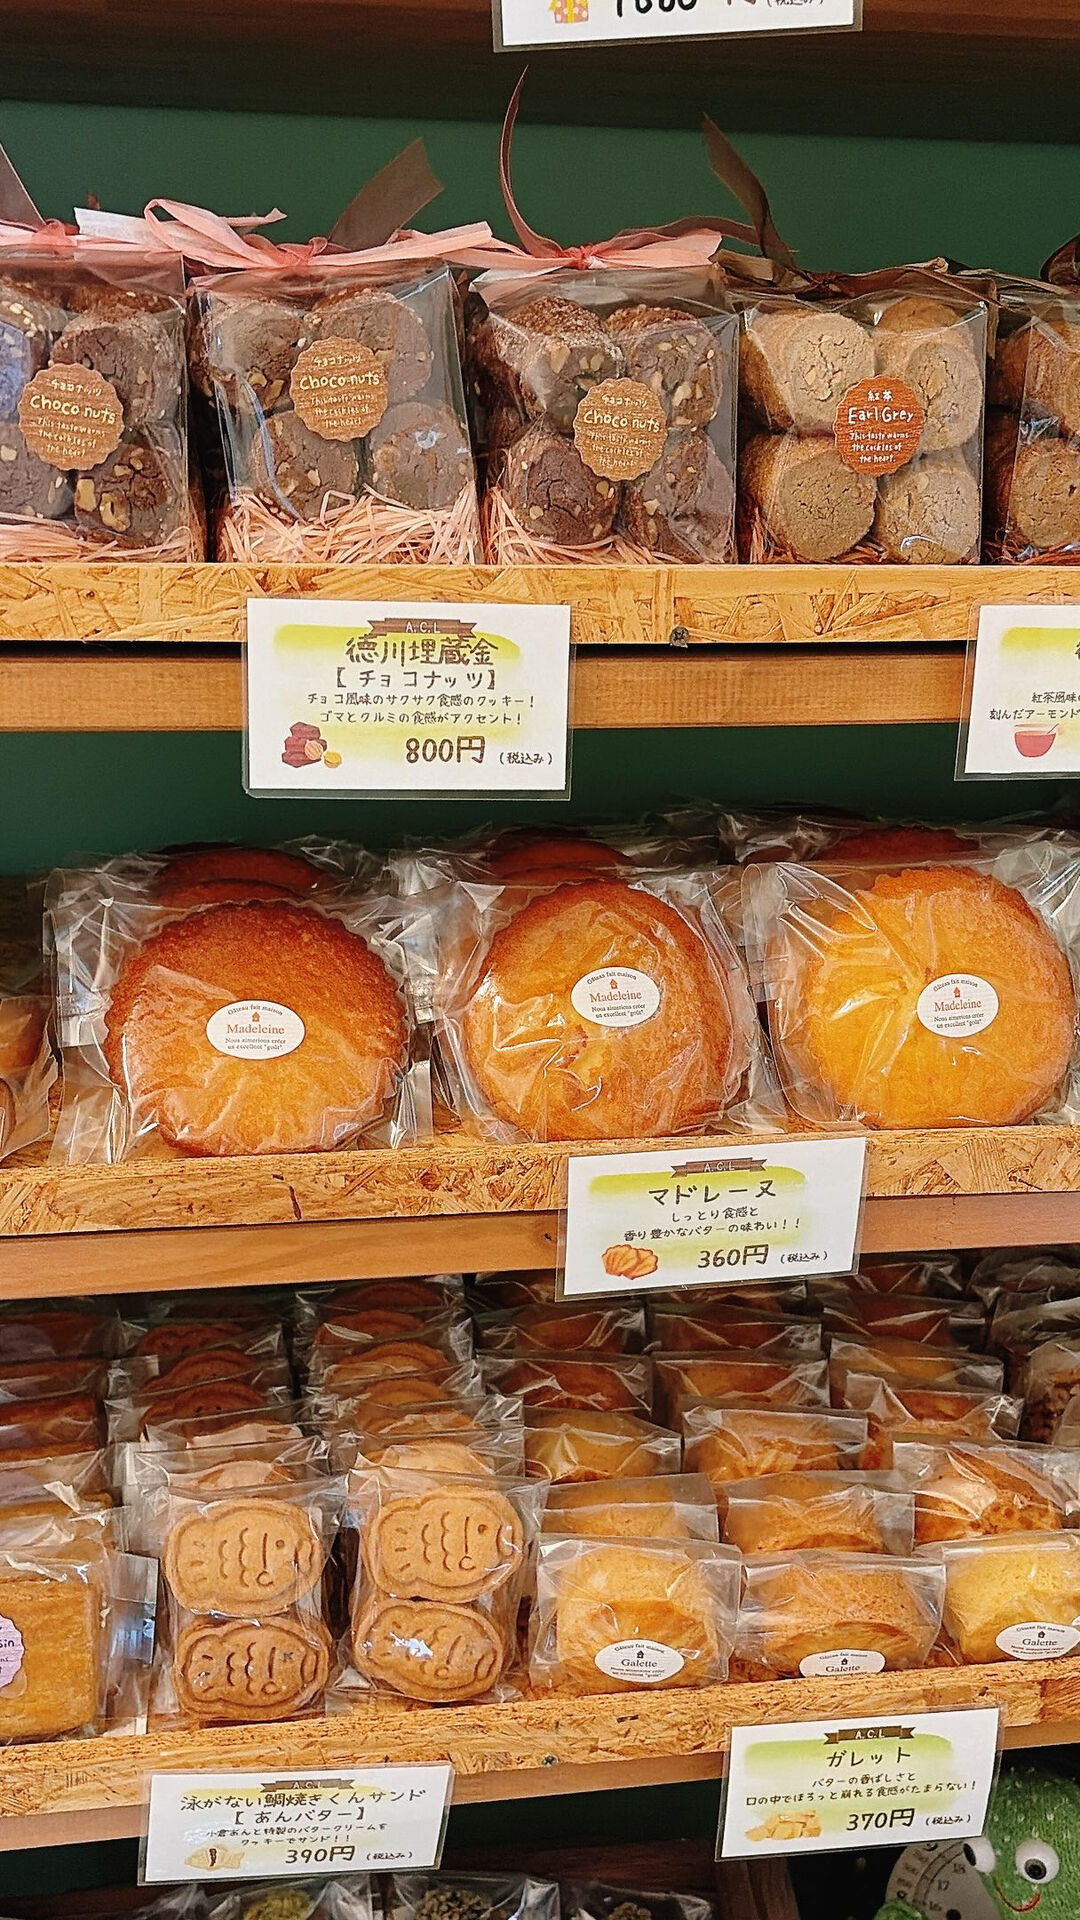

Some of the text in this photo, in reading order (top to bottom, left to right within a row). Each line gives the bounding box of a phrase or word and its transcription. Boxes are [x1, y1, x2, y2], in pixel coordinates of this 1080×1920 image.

[350, 371, 380, 386] nuts
[867, 390, 894, 401] 紅茶
[84, 406, 116, 425] nuts
[314, 408, 327, 416] the
[362, 404, 369, 414] of
[848, 406, 914, 424] Earl Grey
[325, 419, 338, 428] the
[632, 418, 660, 433] nuts
[39, 430, 52, 438] the
[87, 439, 97, 449] of
[849, 432, 865, 440] This
[867, 431, 886, 440] taste
[47, 444, 60, 453] the
[592, 444, 604, 452] the
[635, 449, 644, 458] of
[852, 444, 864, 452] the
[894, 443, 902, 452] of
[860, 454, 872, 464] the
[345, 636, 499, 668] 徳川埋蔵金
[336, 667, 496, 690] 【チョコナッツ】
[307, 692, 535, 708] チョコ風味のサクサク食感のクッキー！
[1031, 691, 1080, 704] 紅茶風味
[320, 711, 522, 726] ゴマとクルミの食感がアクセント！
[405, 735, 485, 765] 800円
[617, 972, 637, 980] maison
[589, 990, 642, 1003] Madeleine
[262, 1005, 283, 1016] maison
[934, 999, 982, 1012] Madeleine
[226, 1024, 285, 1034] Madeleine
[648, 1179, 777, 1206] マドレーヌ
[671, 1206, 759, 1223] しっとり食感と
[697, 1243, 769, 1269] 360円
[1022, 1638, 1058, 1646] Galette
[621, 1658, 658, 1668] Galette
[825, 1665, 861, 1673] Galette
[826, 1746, 911, 1769] ガレット
[812, 1772, 917, 1788] バターの香ばしさと
[180, 1788, 427, 1811] 泳がない鯛焼きくんサンド
[235, 1808, 365, 1826] 【あんバター】
[846, 1807, 916, 1832] 370円
[285, 1845, 356, 1866] 390円
